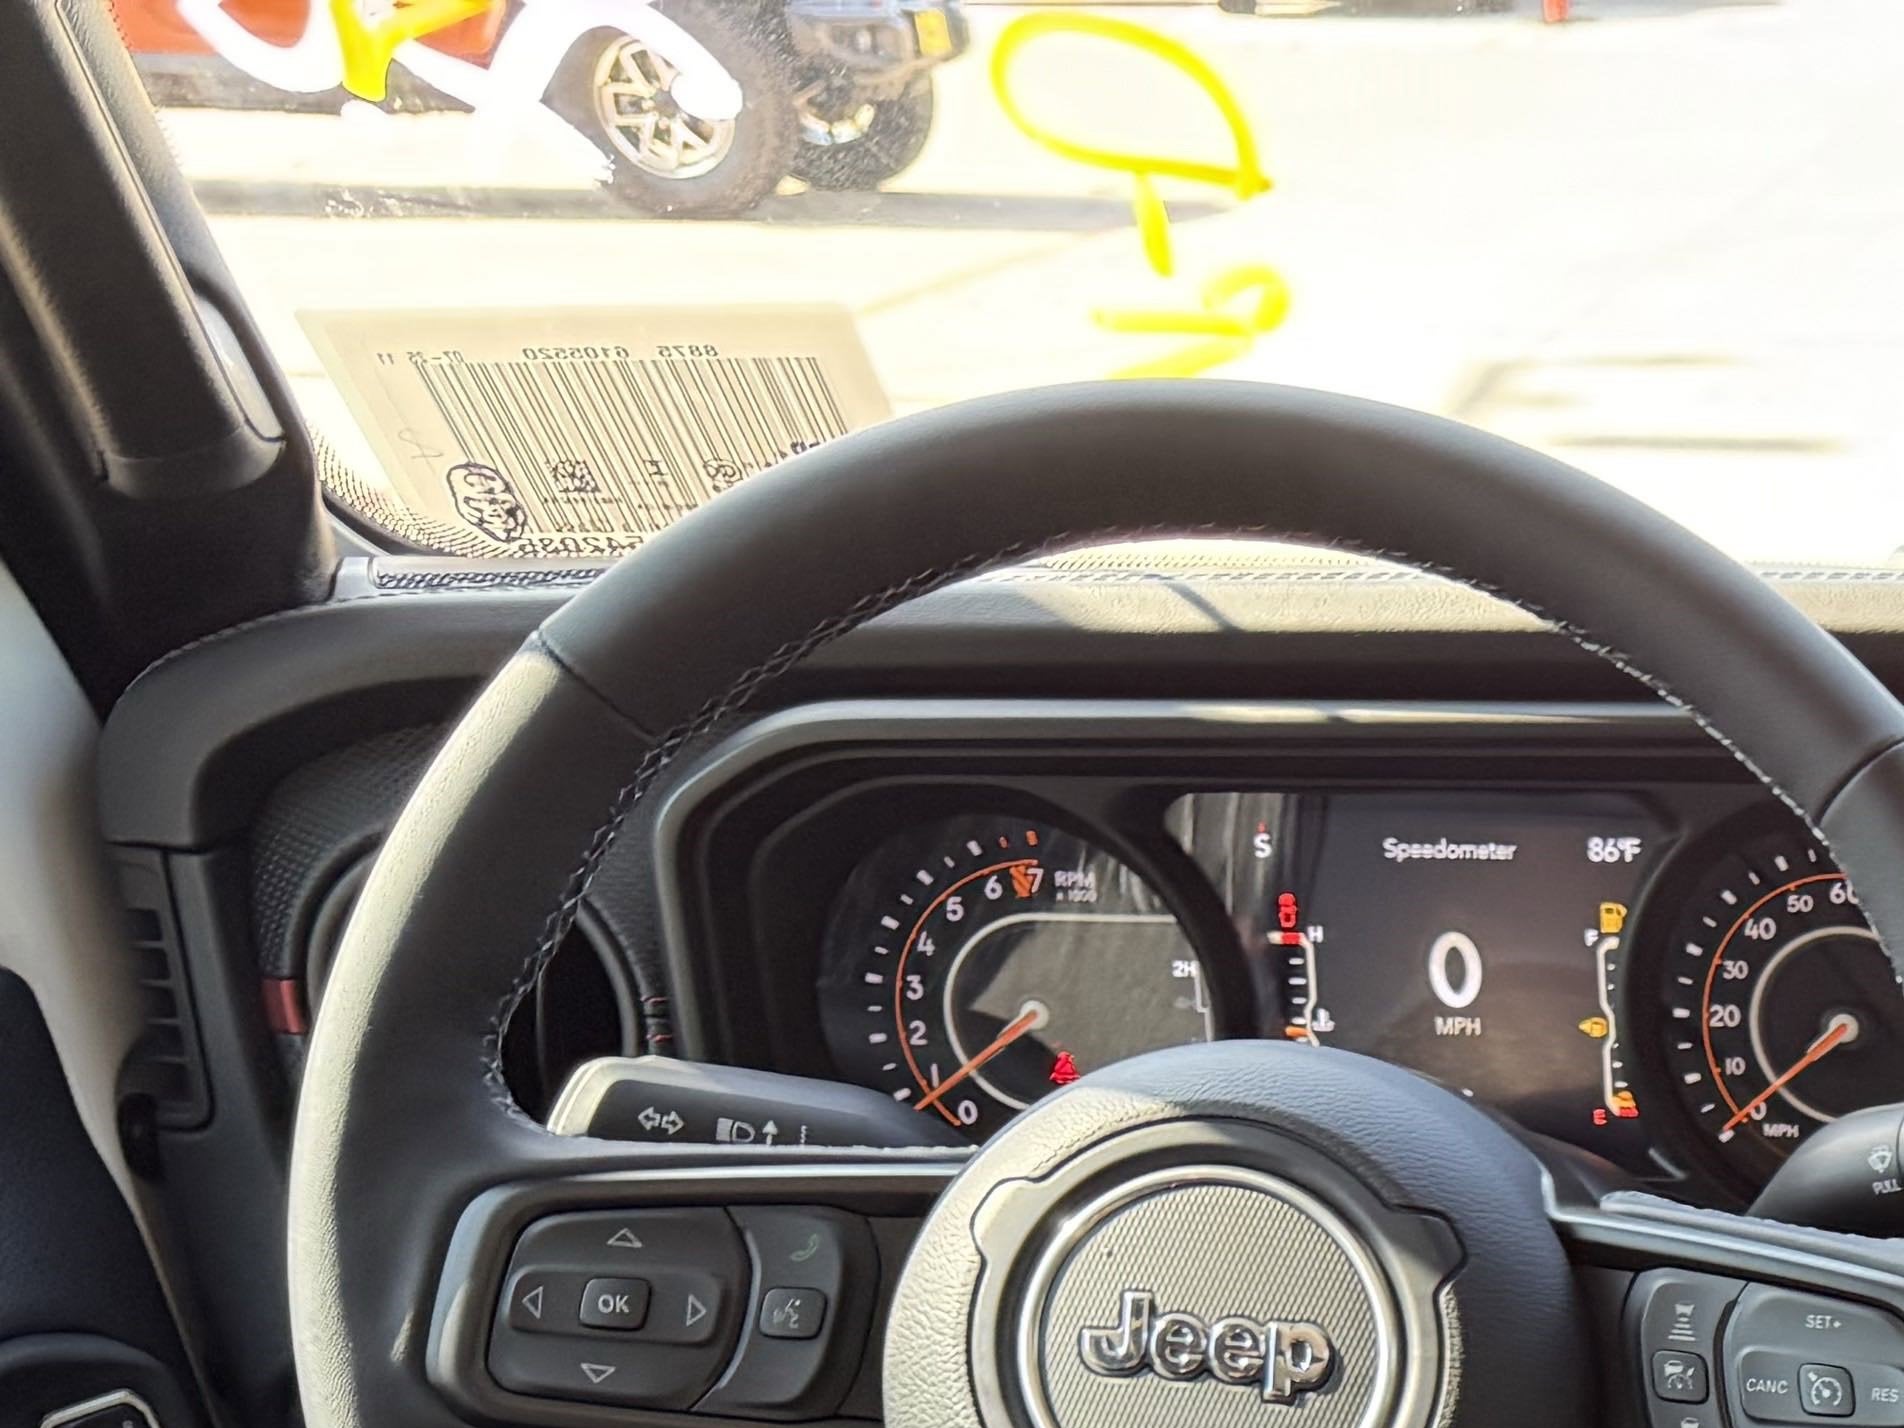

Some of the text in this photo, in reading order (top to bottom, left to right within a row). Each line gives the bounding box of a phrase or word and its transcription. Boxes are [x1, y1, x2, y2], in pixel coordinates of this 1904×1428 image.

[1383, 838, 1517, 863] Speedometer
[985, 875, 1002, 899] 6
[1027, 868, 1044, 893] 7
[1054, 871, 1096, 889] RPM
[946, 896, 964, 922] 5
[1786, 895, 1813, 914] 50
[1744, 918, 1776, 940] 40
[917, 932, 935, 957] 4
[1429, 931, 1483, 1008] 0
[1723, 961, 1749, 980] 30
[906, 974, 924, 1000] 3
[1434, 1016, 1482, 1037] MPH
[1710, 1006, 1741, 1027] 20
[909, 1020, 928, 1046] 2
[1725, 1057, 1745, 1075] 10
[958, 1100, 978, 1126] 0
[1764, 1125, 1799, 1138] MPH
[598, 1294, 630, 1314] OK
[1081, 1290, 1335, 1404] Jeep
[1746, 1378, 1789, 1395] CANC
[1872, 1387, 1900, 1402] RES
